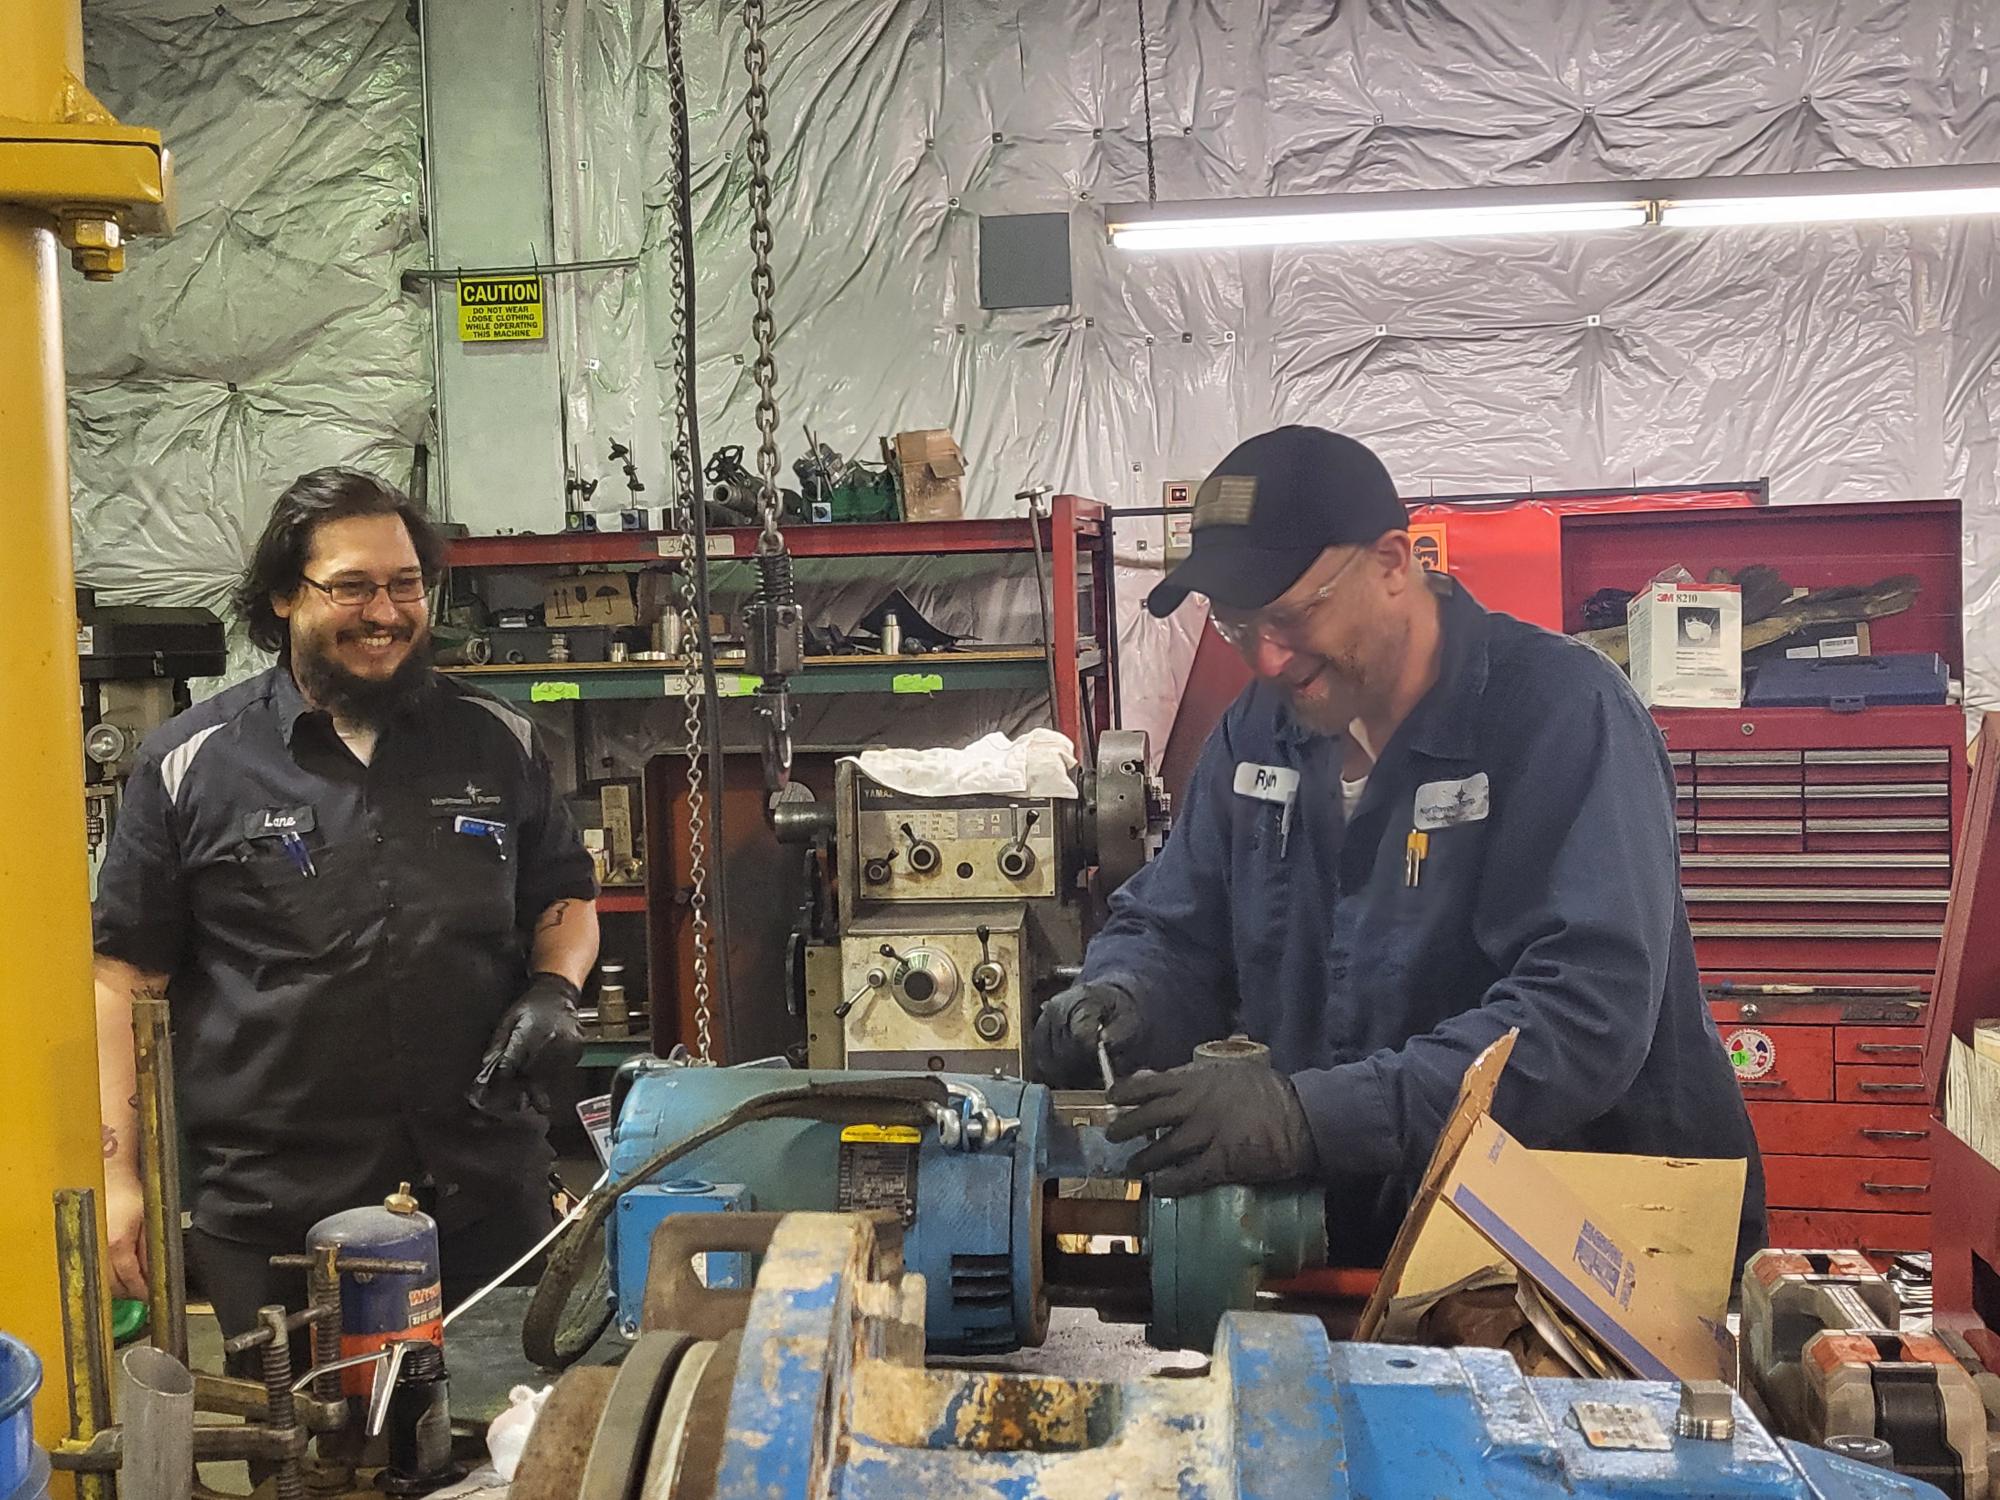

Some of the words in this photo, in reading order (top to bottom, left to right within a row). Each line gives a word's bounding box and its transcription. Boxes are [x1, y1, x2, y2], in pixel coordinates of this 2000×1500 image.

[463, 283, 538, 302] CAUTION
[473, 307, 484, 315] DO
[487, 306, 502, 314] NOT
[505, 305, 529, 313] WEAR
[467, 315, 493, 323] LOOSE
[495, 313, 535, 322] CLOTHING
[465, 322, 491, 331] WHILE
[493, 321, 538, 330] OPERATING
[493, 329, 531, 338] MACHINE
[1656, 592, 1674, 603] 3M
[1675, 593, 1698, 604] 8210
[264, 812, 296, 827] Lane
